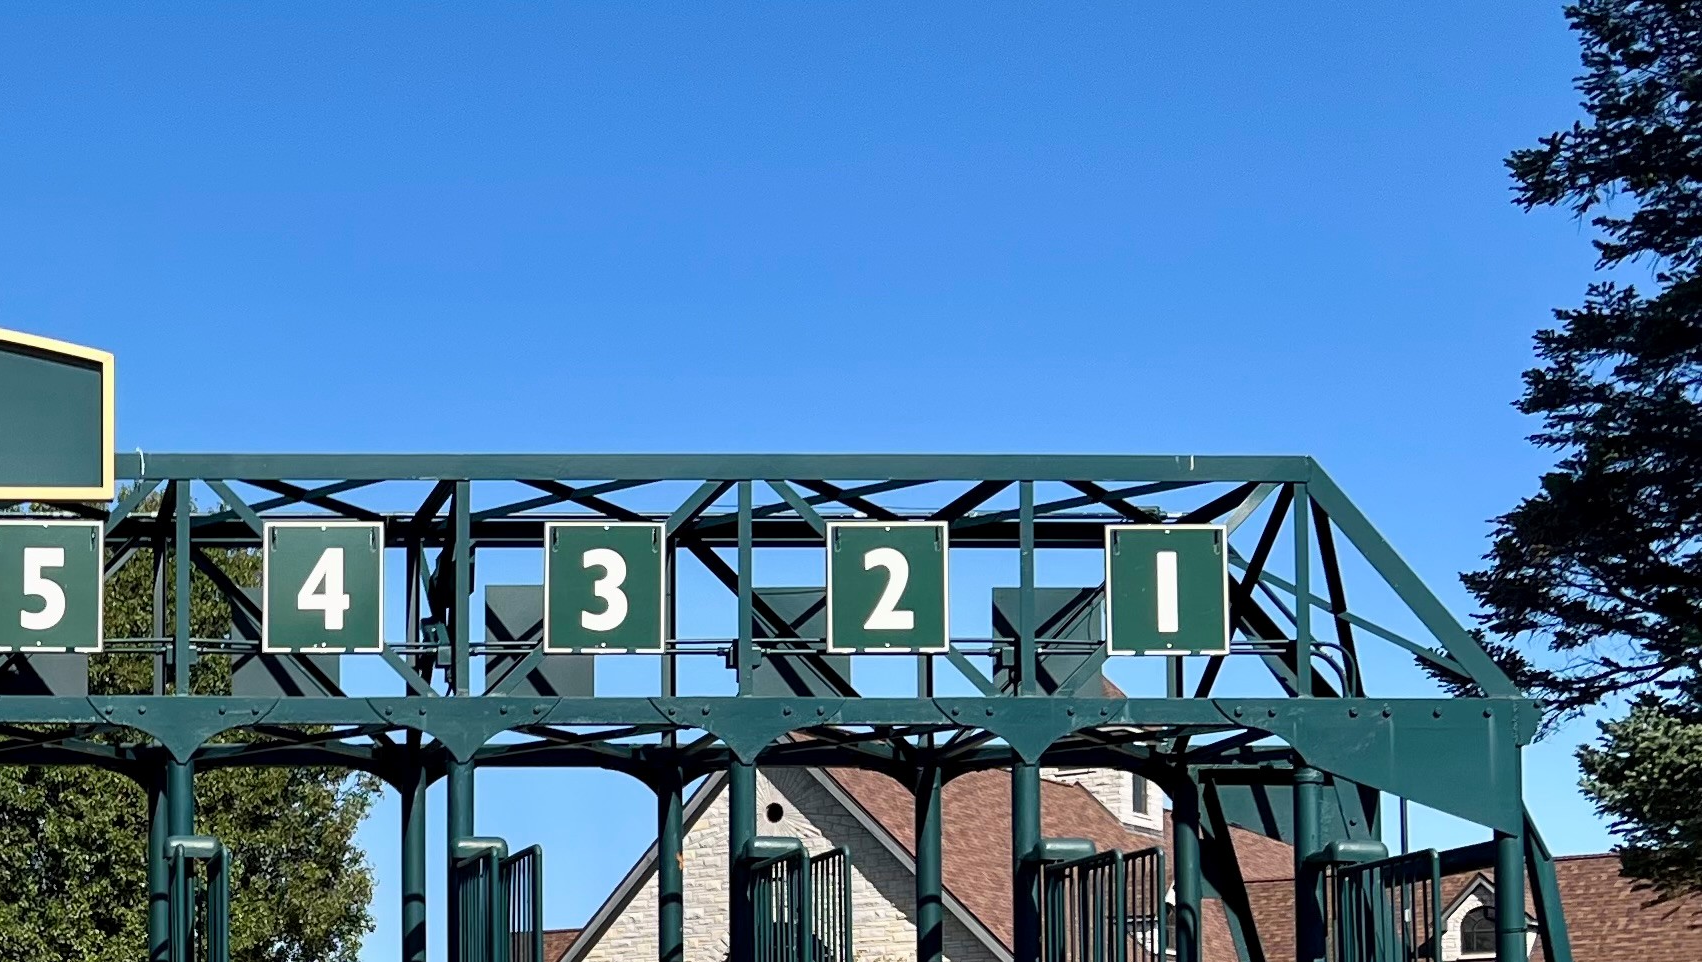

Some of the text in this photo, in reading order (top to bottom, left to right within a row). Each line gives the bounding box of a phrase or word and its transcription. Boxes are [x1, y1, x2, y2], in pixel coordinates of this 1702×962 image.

[20, 547, 66, 630] 5
[297, 547, 350, 630] 4
[581, 548, 628, 632] 3
[863, 547, 914, 630] 2
[1156, 551, 1179, 633] 1
